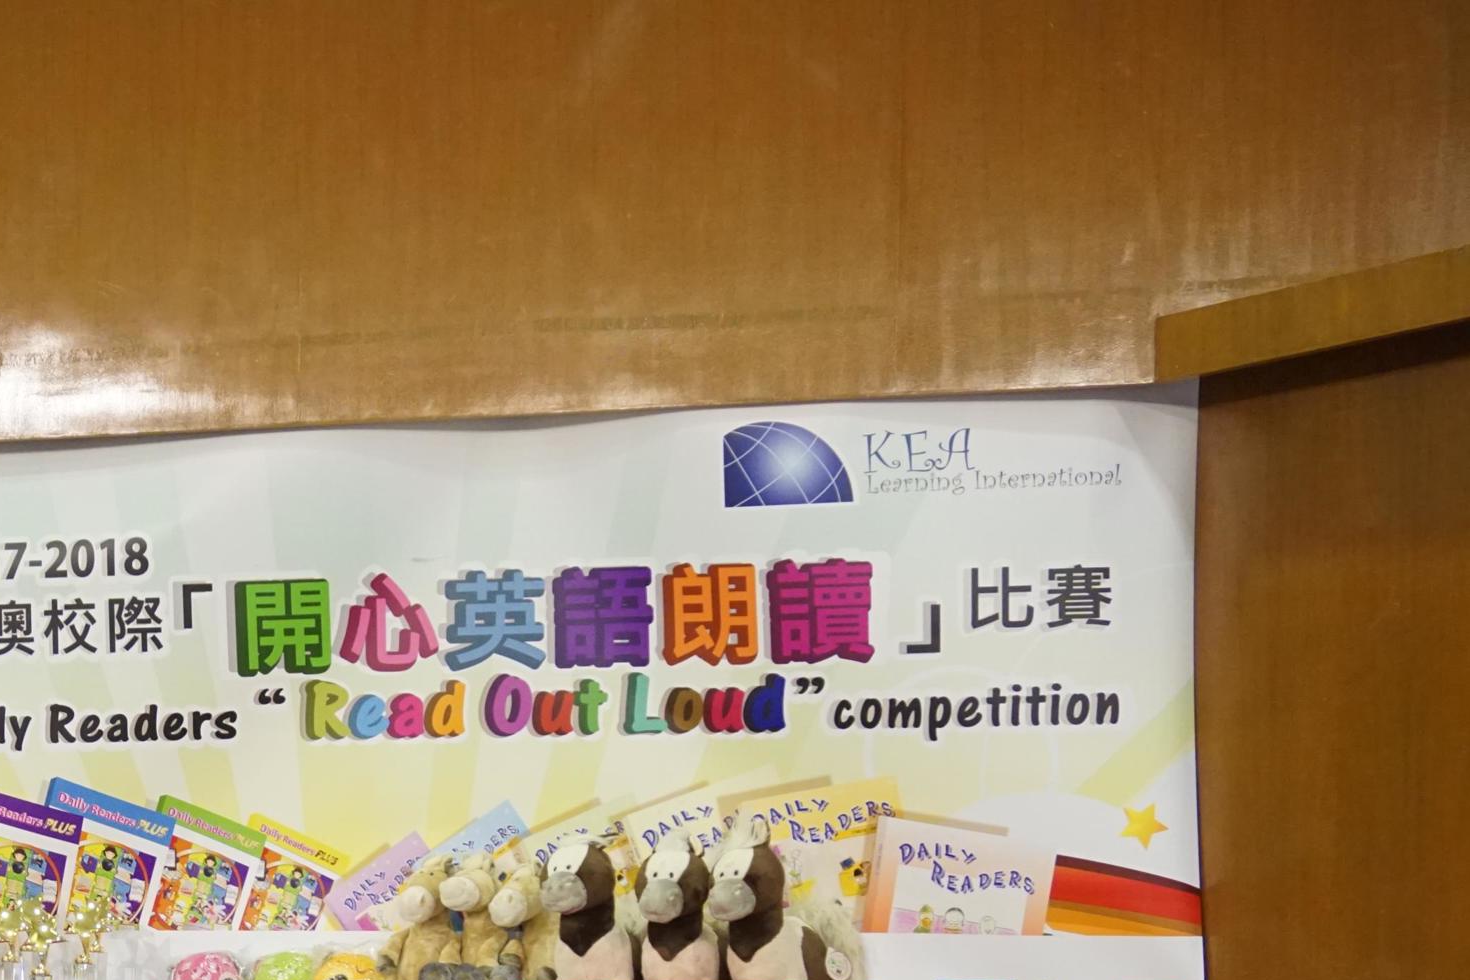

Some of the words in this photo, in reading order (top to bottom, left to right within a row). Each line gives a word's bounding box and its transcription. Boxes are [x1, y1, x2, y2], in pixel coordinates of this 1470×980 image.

[863, 428, 976, 473] KEA
[866, 472, 966, 495] Learning
[975, 464, 1122, 490] International
[47, 704, 238, 743] Readers
[484, 673, 608, 736] Out
[833, 683, 1120, 741] competition
[45, 817, 77, 836] PLUS
[59, 791, 90, 813] Daily
[91, 806, 137, 828] Readers
[138, 818, 169, 838] PLUS
[642, 805, 714, 849] DAILY
[788, 801, 896, 844] READERS
[899, 843, 977, 865] DAILY
[344, 871, 387, 911] DAILY
[931, 860, 1035, 895] READERS
